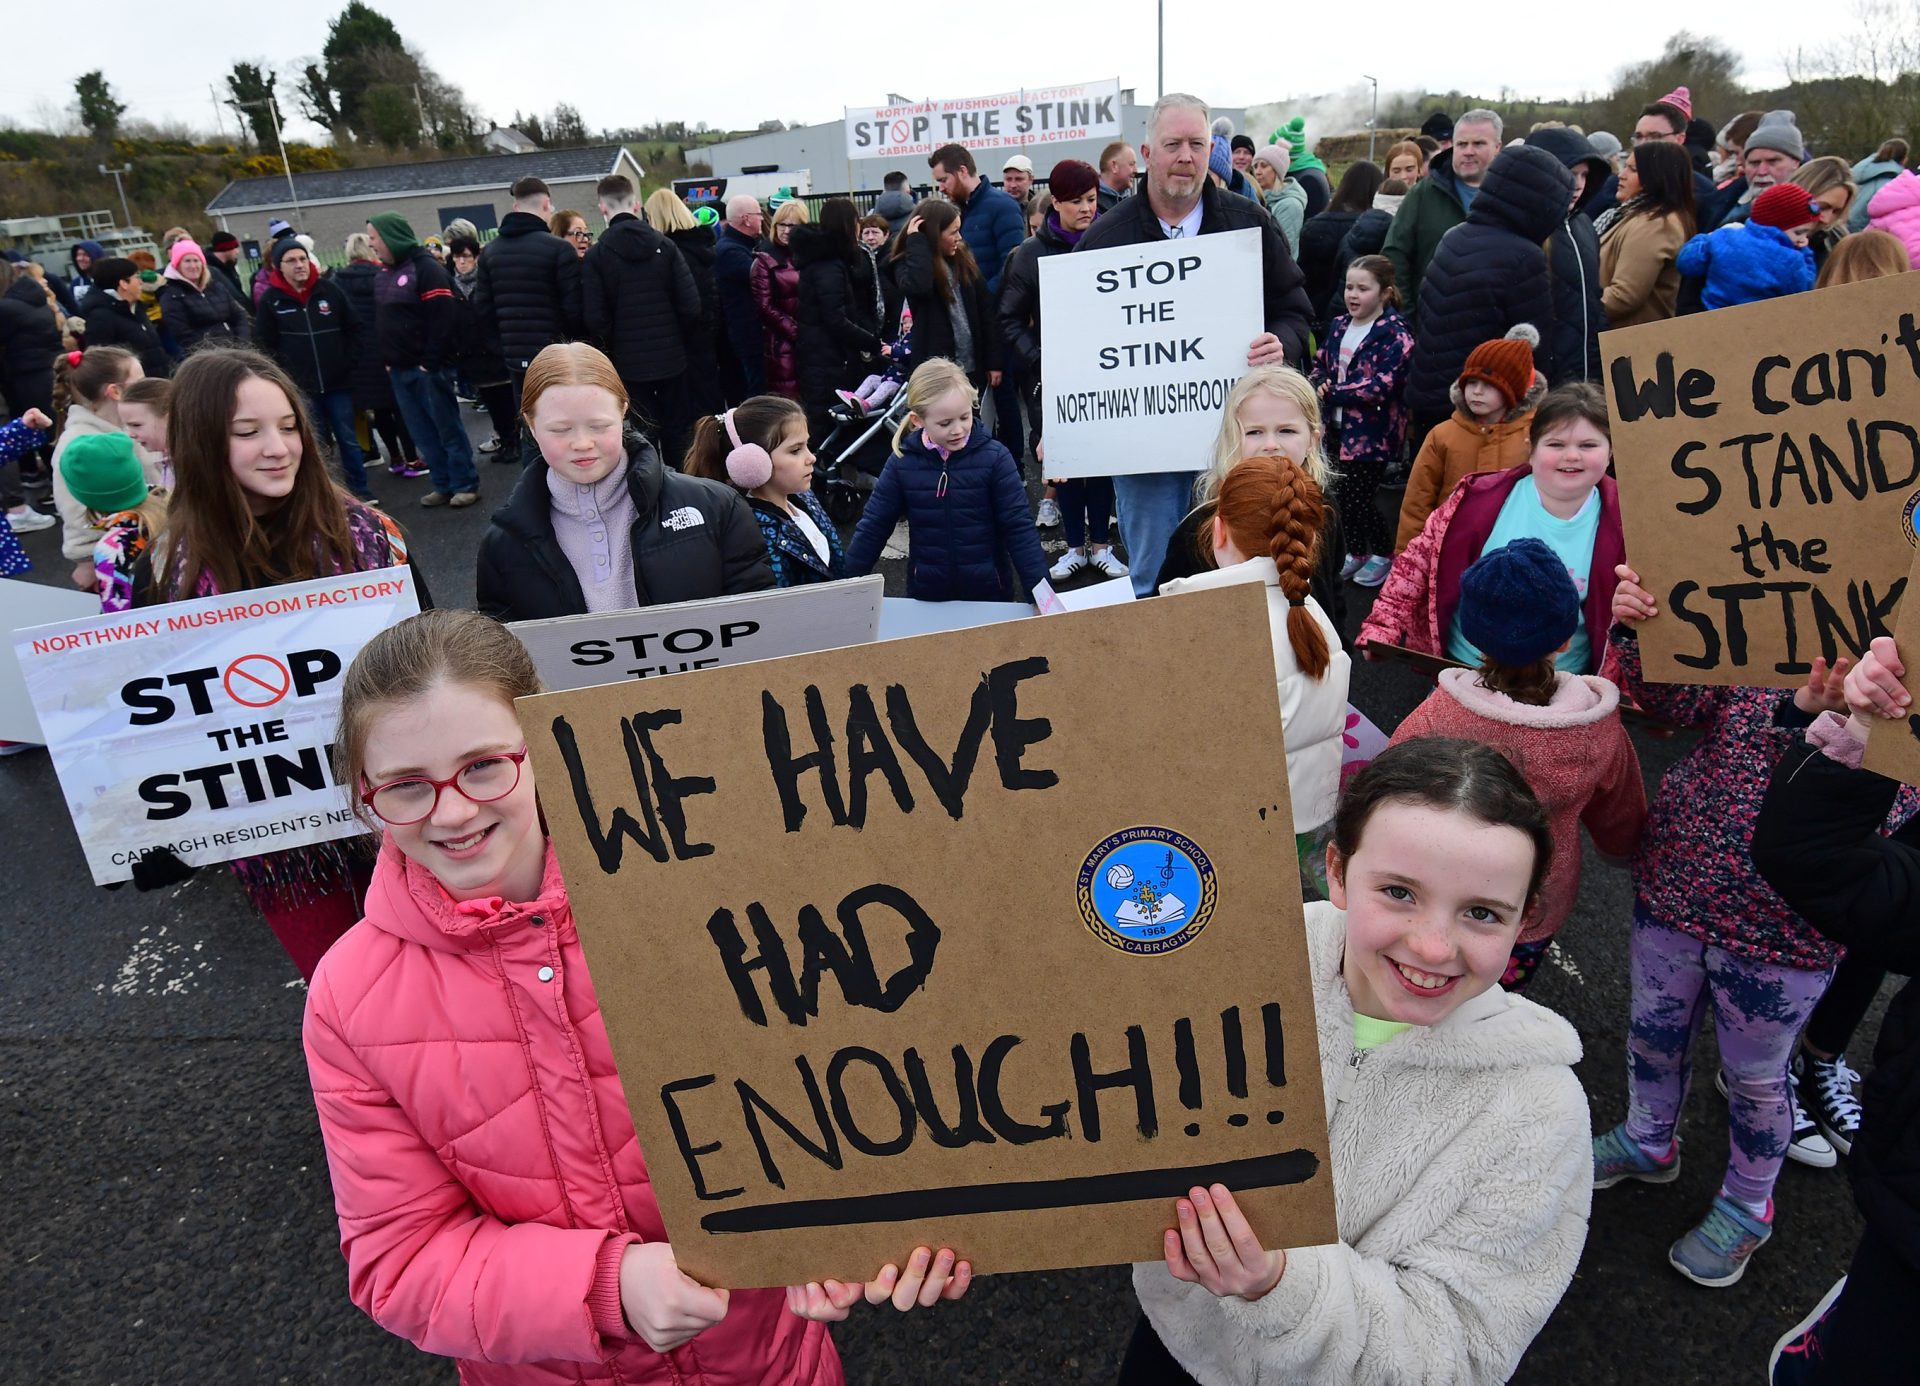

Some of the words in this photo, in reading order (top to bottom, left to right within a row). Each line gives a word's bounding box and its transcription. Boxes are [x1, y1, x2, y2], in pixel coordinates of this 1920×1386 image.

[876, 103, 938, 118] NORTHWAY
[944, 95, 1019, 110] MUSHROOM
[1024, 86, 1085, 102] FACTORY
[942, 110, 1000, 139] THE
[1016, 95, 1115, 133] STINK
[878, 143, 931, 156] CABRAGH
[1004, 134, 1035, 145] NEED
[1041, 128, 1086, 142] ACTION
[1096, 256, 1202, 293] STOP
[1121, 300, 1175, 325] THE
[1099, 337, 1205, 370] STINK
[1610, 348, 1722, 422] We
[1752, 313, 1920, 415] can't
[1057, 387, 1139, 424] NORTHWAY
[1671, 417, 1920, 516] STAND
[661, 514, 690, 528] NORTH
[669, 508, 687, 517] THE
[672, 520, 693, 531] FACE
[1730, 520, 1832, 577] the
[32, 619, 160, 655] NORTHWAY
[168, 597, 301, 632] MUSHROOM
[306, 579, 405, 608] FACTORY
[1668, 577, 1908, 674] STINK
[569, 620, 760, 666] STOP
[207, 719, 289, 751] THE
[551, 708, 715, 874] WE
[761, 656, 1059, 831] HAVE
[213, 814, 321, 846] RESIDENTS
[1086, 836, 1120, 868] MARY'S
[1121, 829, 1174, 842] PRIMARY
[1174, 836, 1209, 871] SCHOOL
[1126, 934, 1187, 952] CABRAGH
[1141, 926, 1167, 937] 1968
[705, 882, 941, 1027] HAD
[661, 1002, 1287, 1200] ENOUGH!!!
